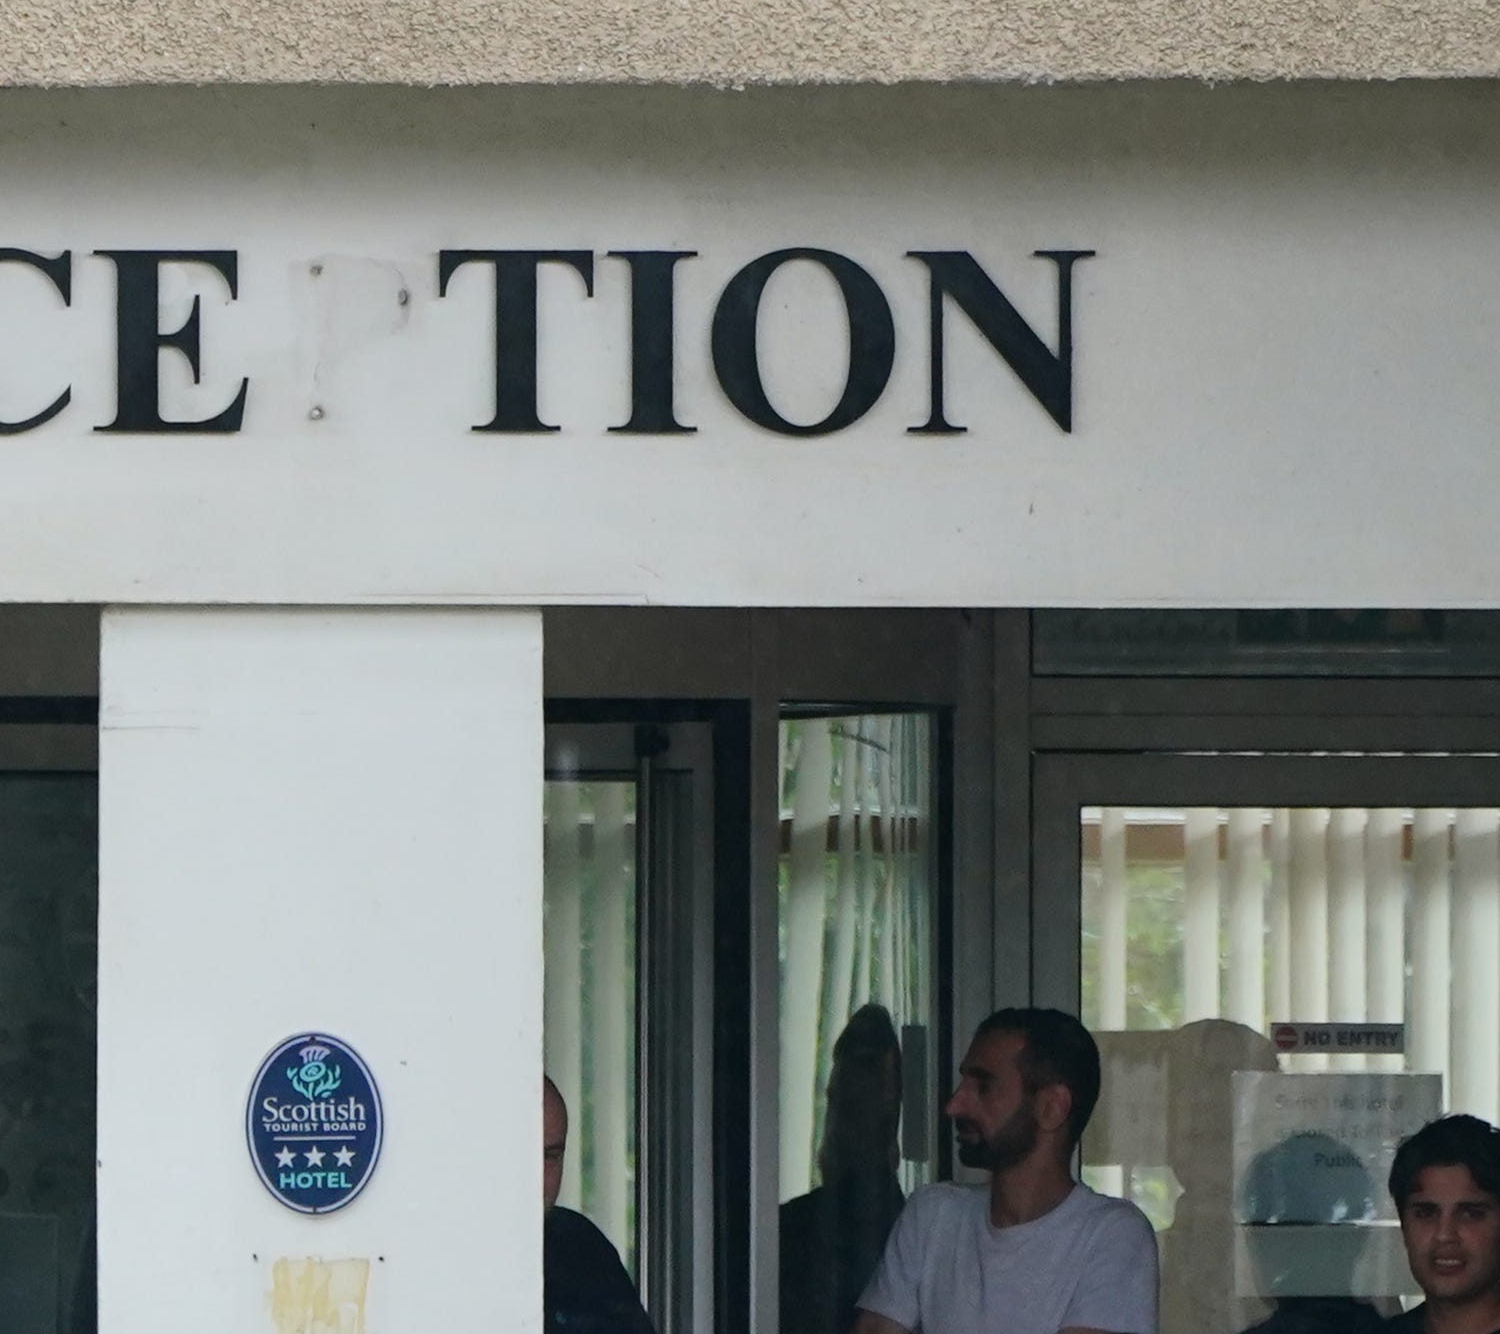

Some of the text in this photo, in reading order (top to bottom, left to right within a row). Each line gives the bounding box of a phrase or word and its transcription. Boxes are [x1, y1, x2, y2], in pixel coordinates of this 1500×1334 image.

[1304, 1030, 1398, 1046] NO ENTRY
[262, 1096, 366, 1123] Scottish
[263, 1122, 367, 1133] TOURIST BOARD
[279, 1172, 353, 1190] HOTEL
